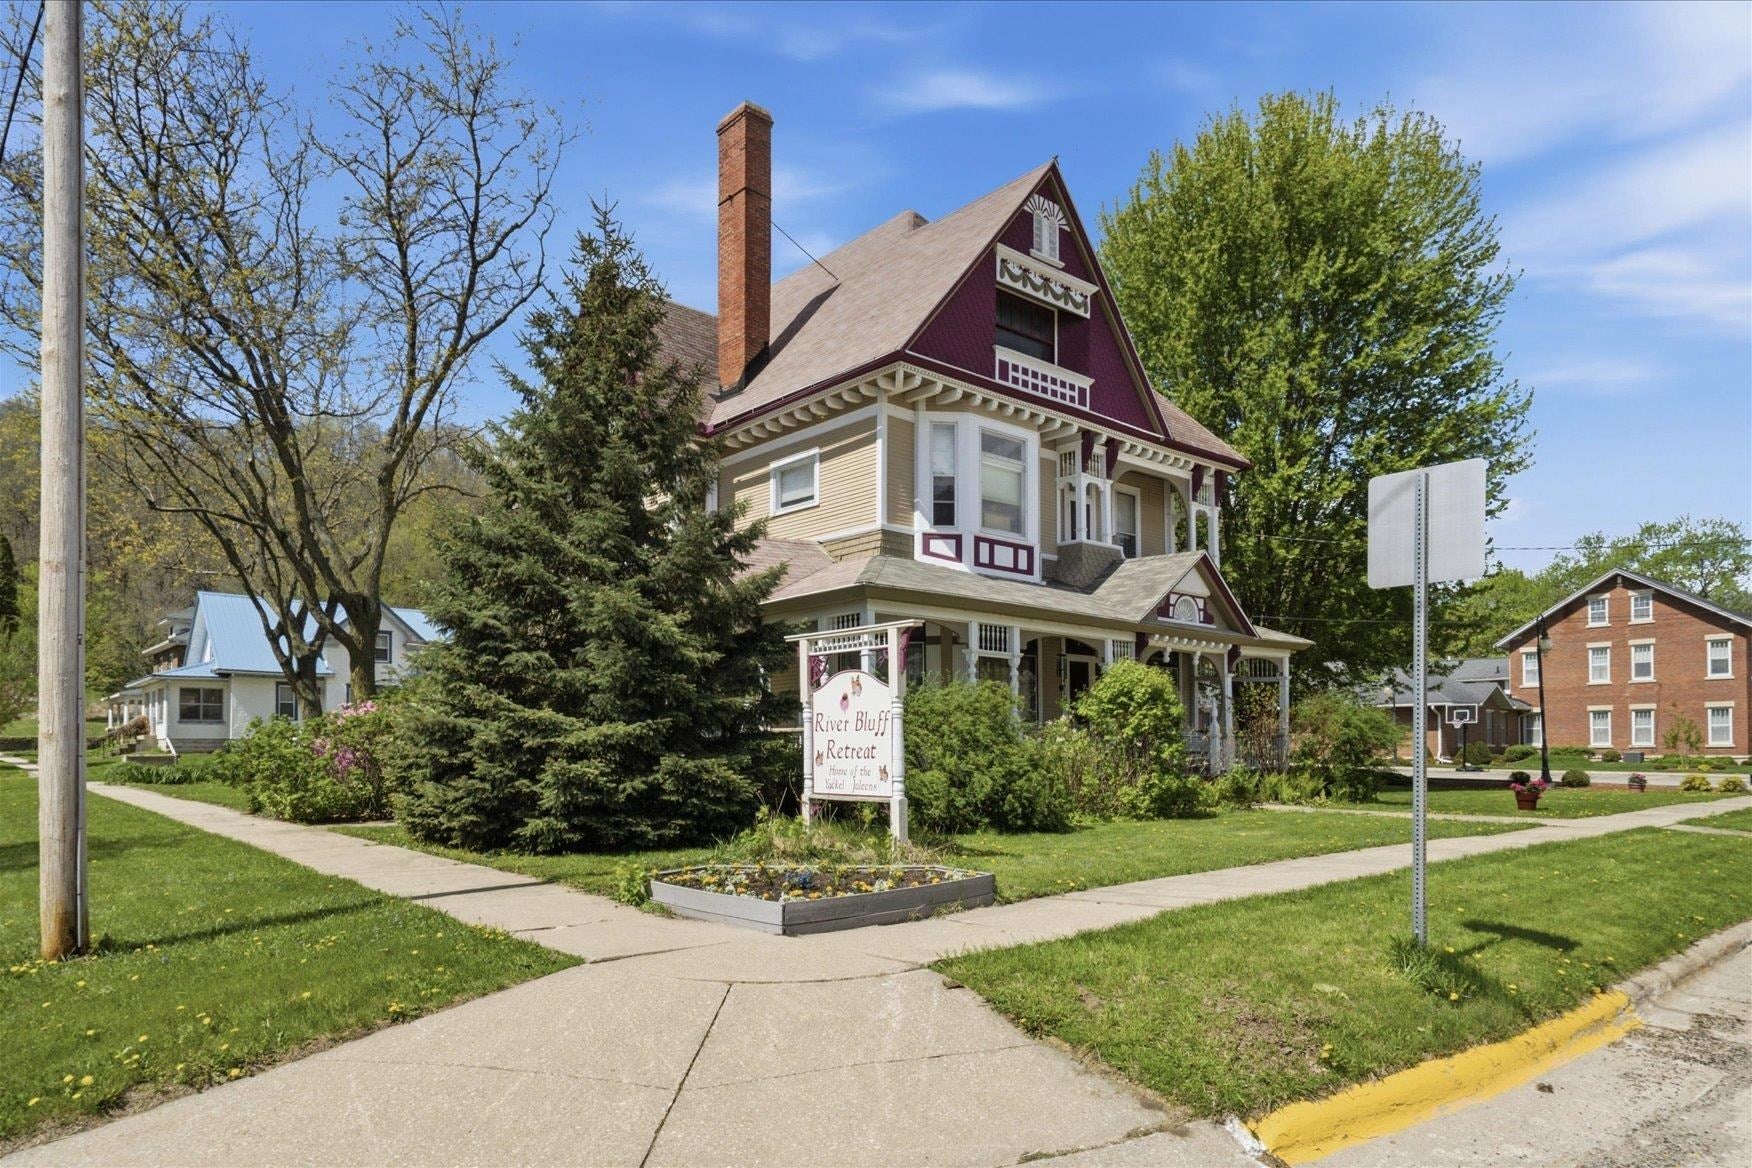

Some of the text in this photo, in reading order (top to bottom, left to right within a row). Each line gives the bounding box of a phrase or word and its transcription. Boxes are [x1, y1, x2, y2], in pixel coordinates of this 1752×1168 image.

[815, 710, 890, 736] River Bluff
[826, 739, 876, 759] Retreat
[829, 765, 871, 778] Home of the
